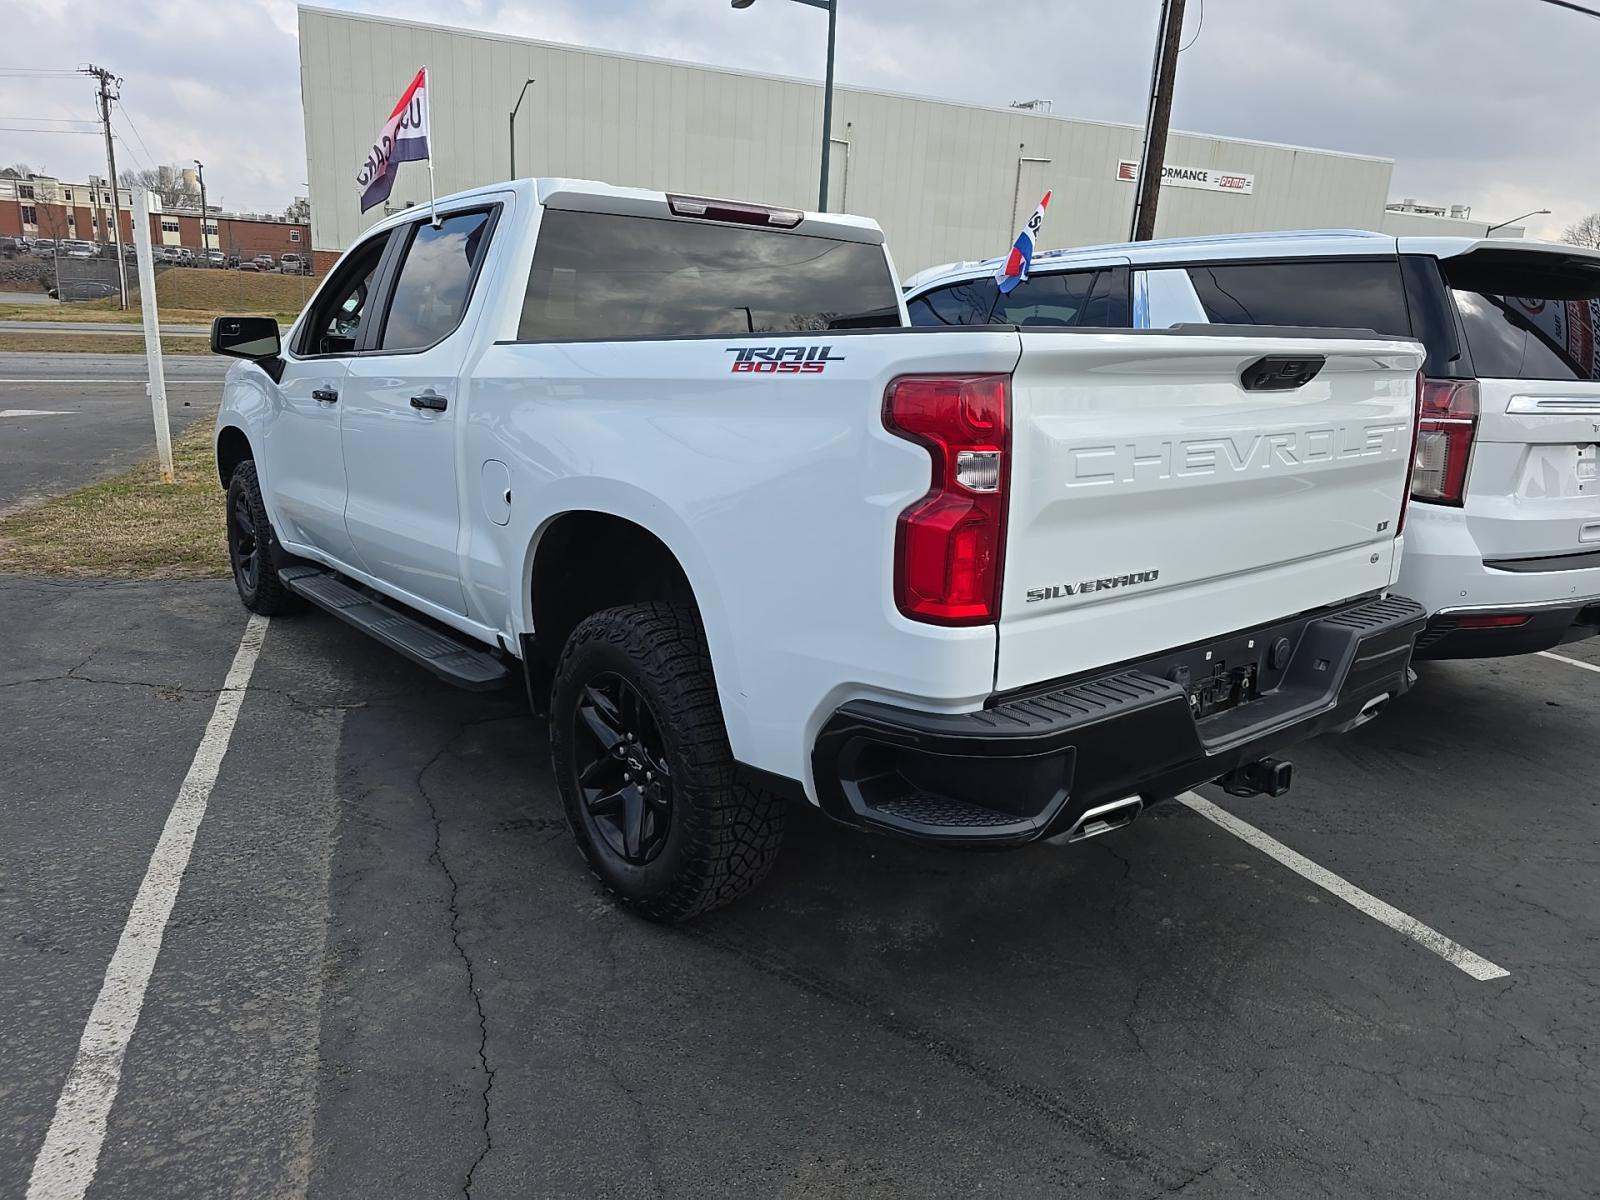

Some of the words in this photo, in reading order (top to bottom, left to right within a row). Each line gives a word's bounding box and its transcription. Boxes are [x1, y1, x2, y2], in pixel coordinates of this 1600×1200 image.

[1161, 168, 1208, 182] ORMANCE
[726, 346, 845, 361] TRAIL
[732, 361, 826, 373] BOSS
[1065, 423, 1407, 487] CHEVROLET
[1377, 520, 1390, 532] LT
[1026, 570, 1159, 602] SILVERADO
